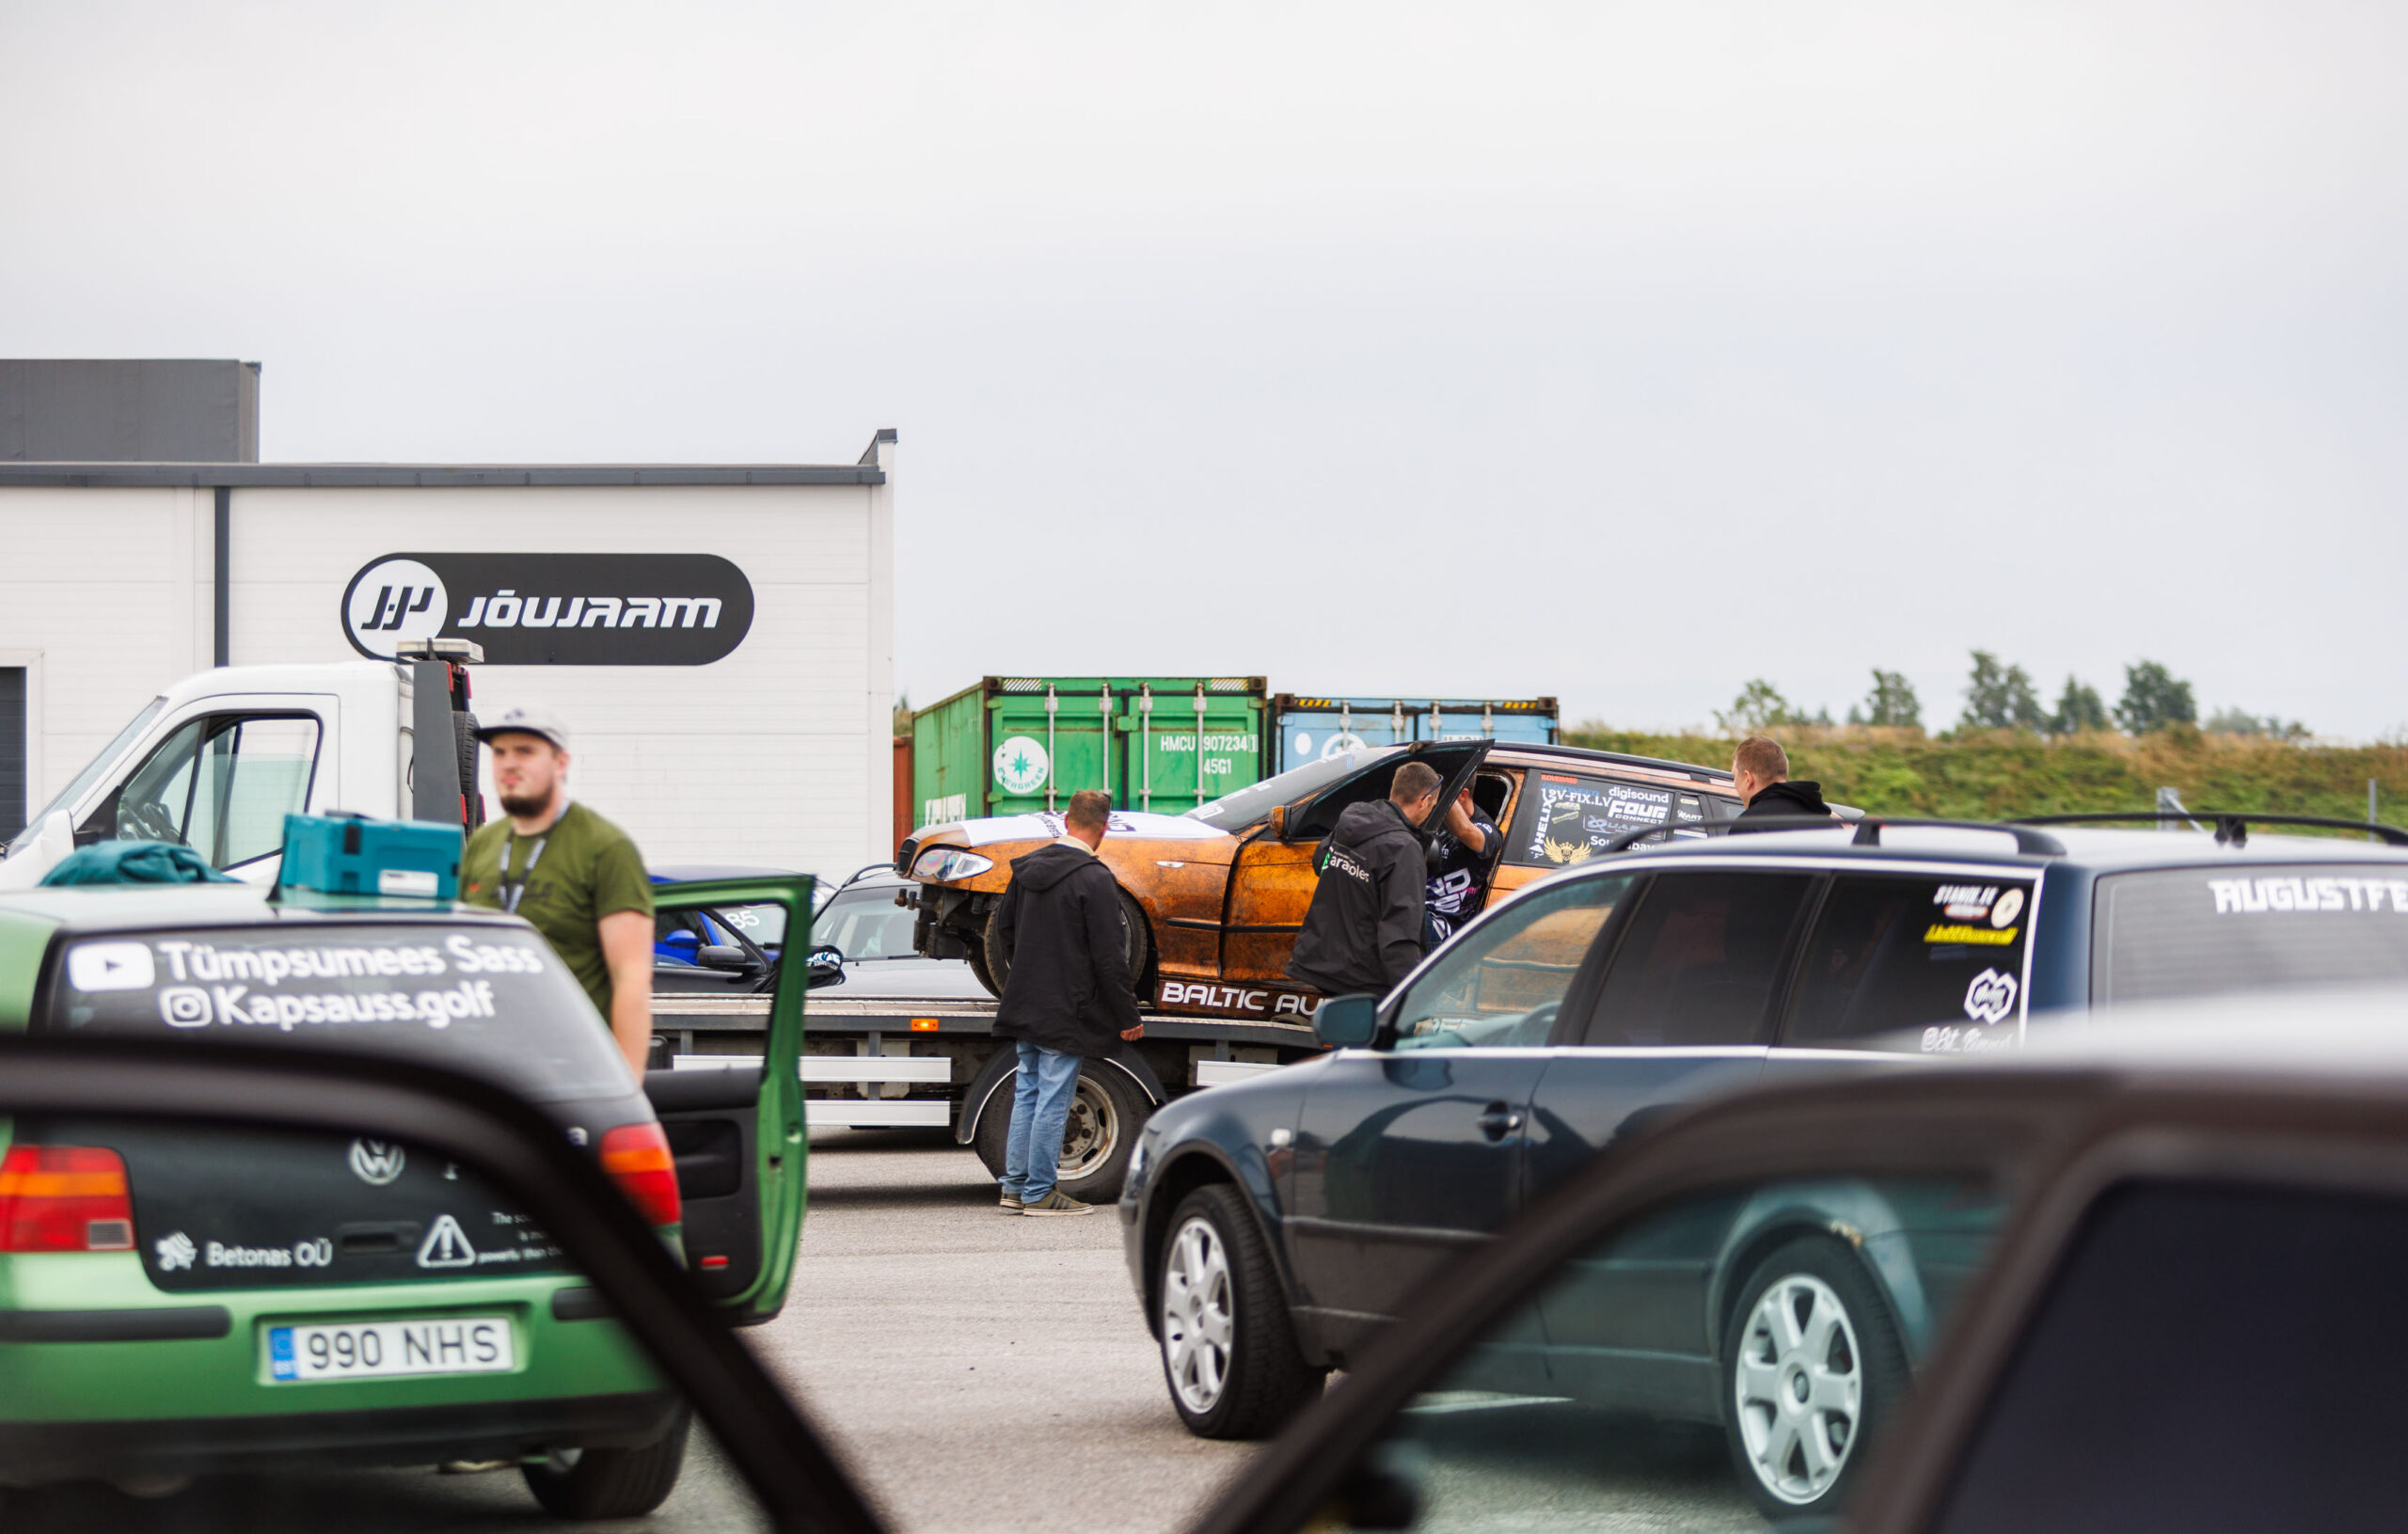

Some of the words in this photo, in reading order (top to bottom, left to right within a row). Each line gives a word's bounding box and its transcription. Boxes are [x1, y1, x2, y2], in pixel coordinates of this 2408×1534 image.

[1161, 735, 1196, 751] HMCU
[1204, 758, 1231, 774] 45G1
[1608, 786, 1669, 803] digisound
[1615, 814, 1663, 824] CONNECT
[156, 942, 447, 987] Tümpsumees
[445, 936, 544, 975] Sass
[214, 980, 496, 1032] Kapsauss.golf
[1162, 982, 1268, 1011] BALTIC
[1275, 994, 1326, 1016] AU
[207, 1241, 293, 1267] Betonas
[294, 1238, 333, 1266] OÜ
[308, 1327, 382, 1369] 990
[404, 1324, 499, 1366] NHS
